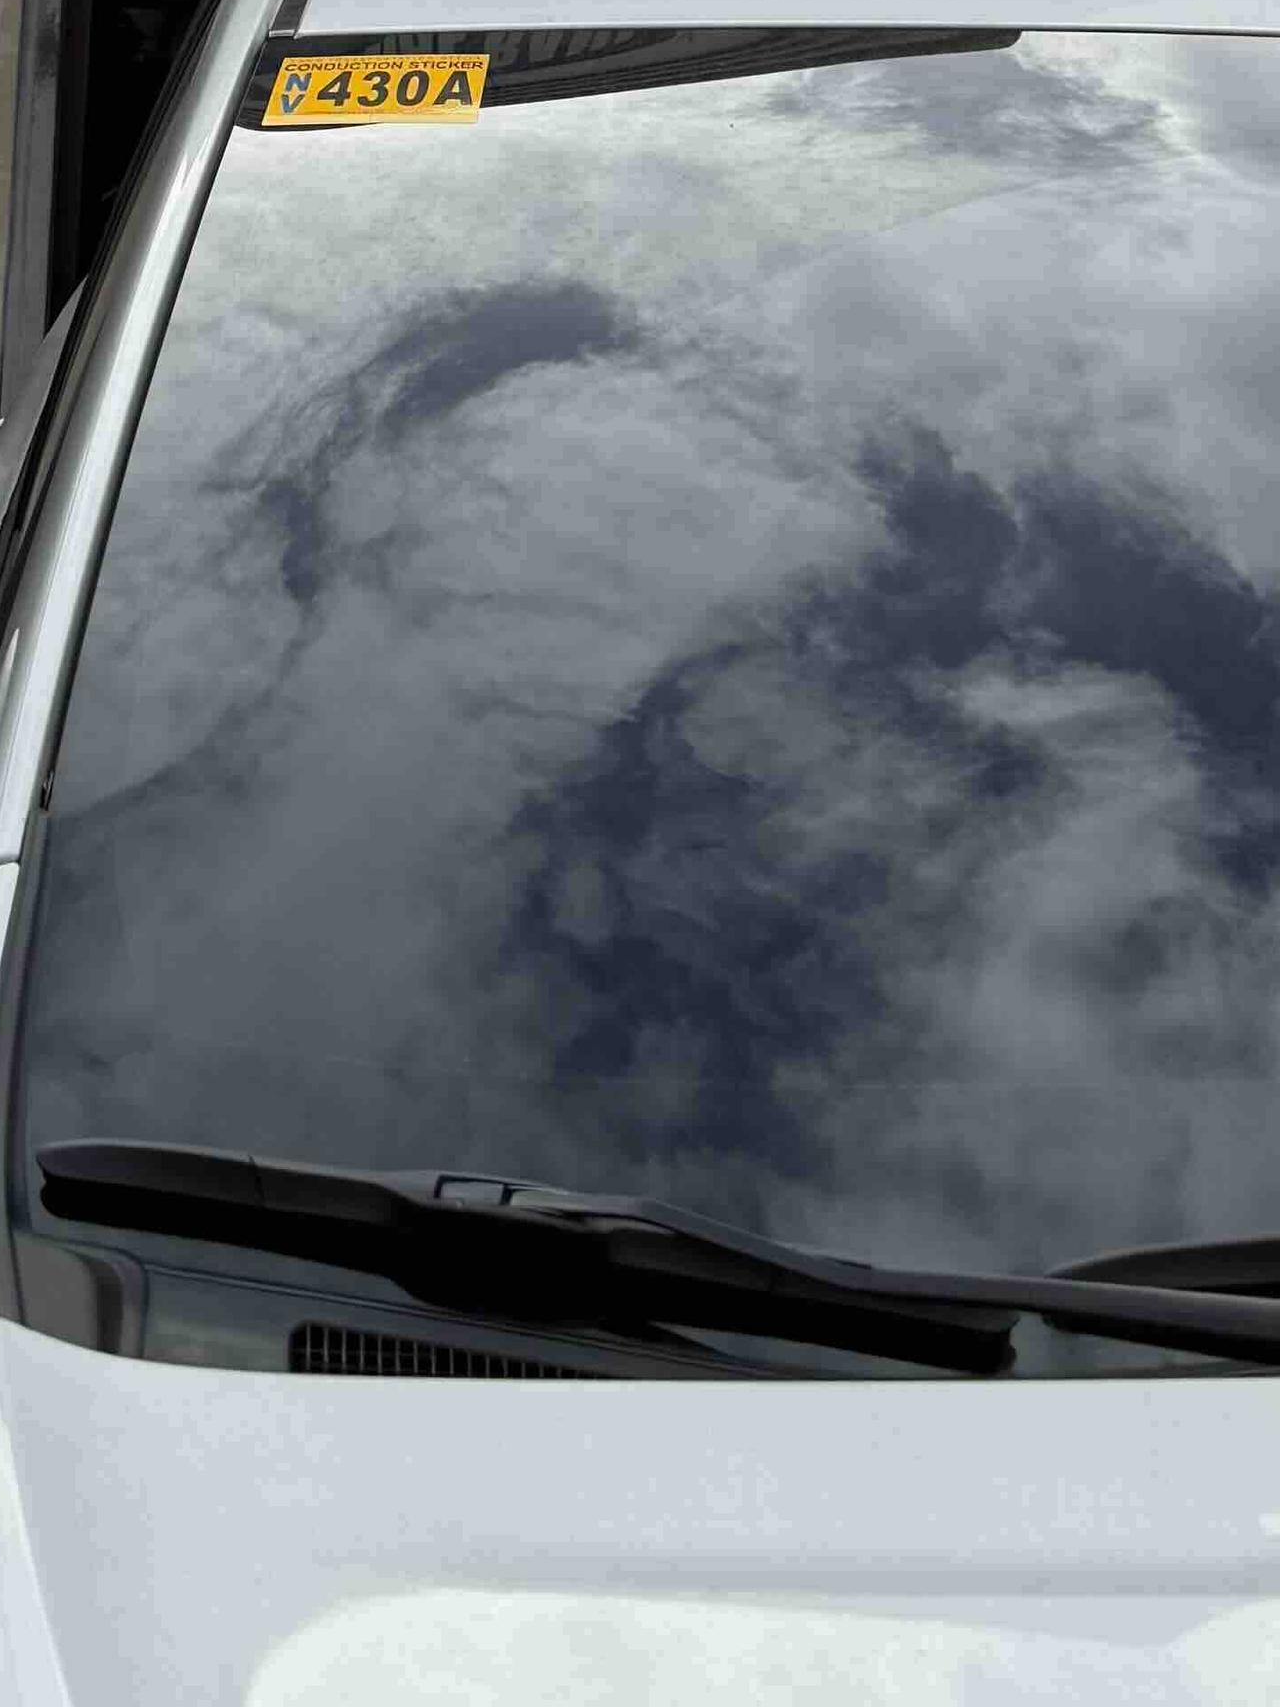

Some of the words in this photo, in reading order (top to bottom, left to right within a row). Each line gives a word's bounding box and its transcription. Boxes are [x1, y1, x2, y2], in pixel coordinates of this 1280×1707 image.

[284, 61, 403, 72] CONDUCTION
[408, 60, 484, 70] STICKER
[316, 70, 473, 107] 430A
